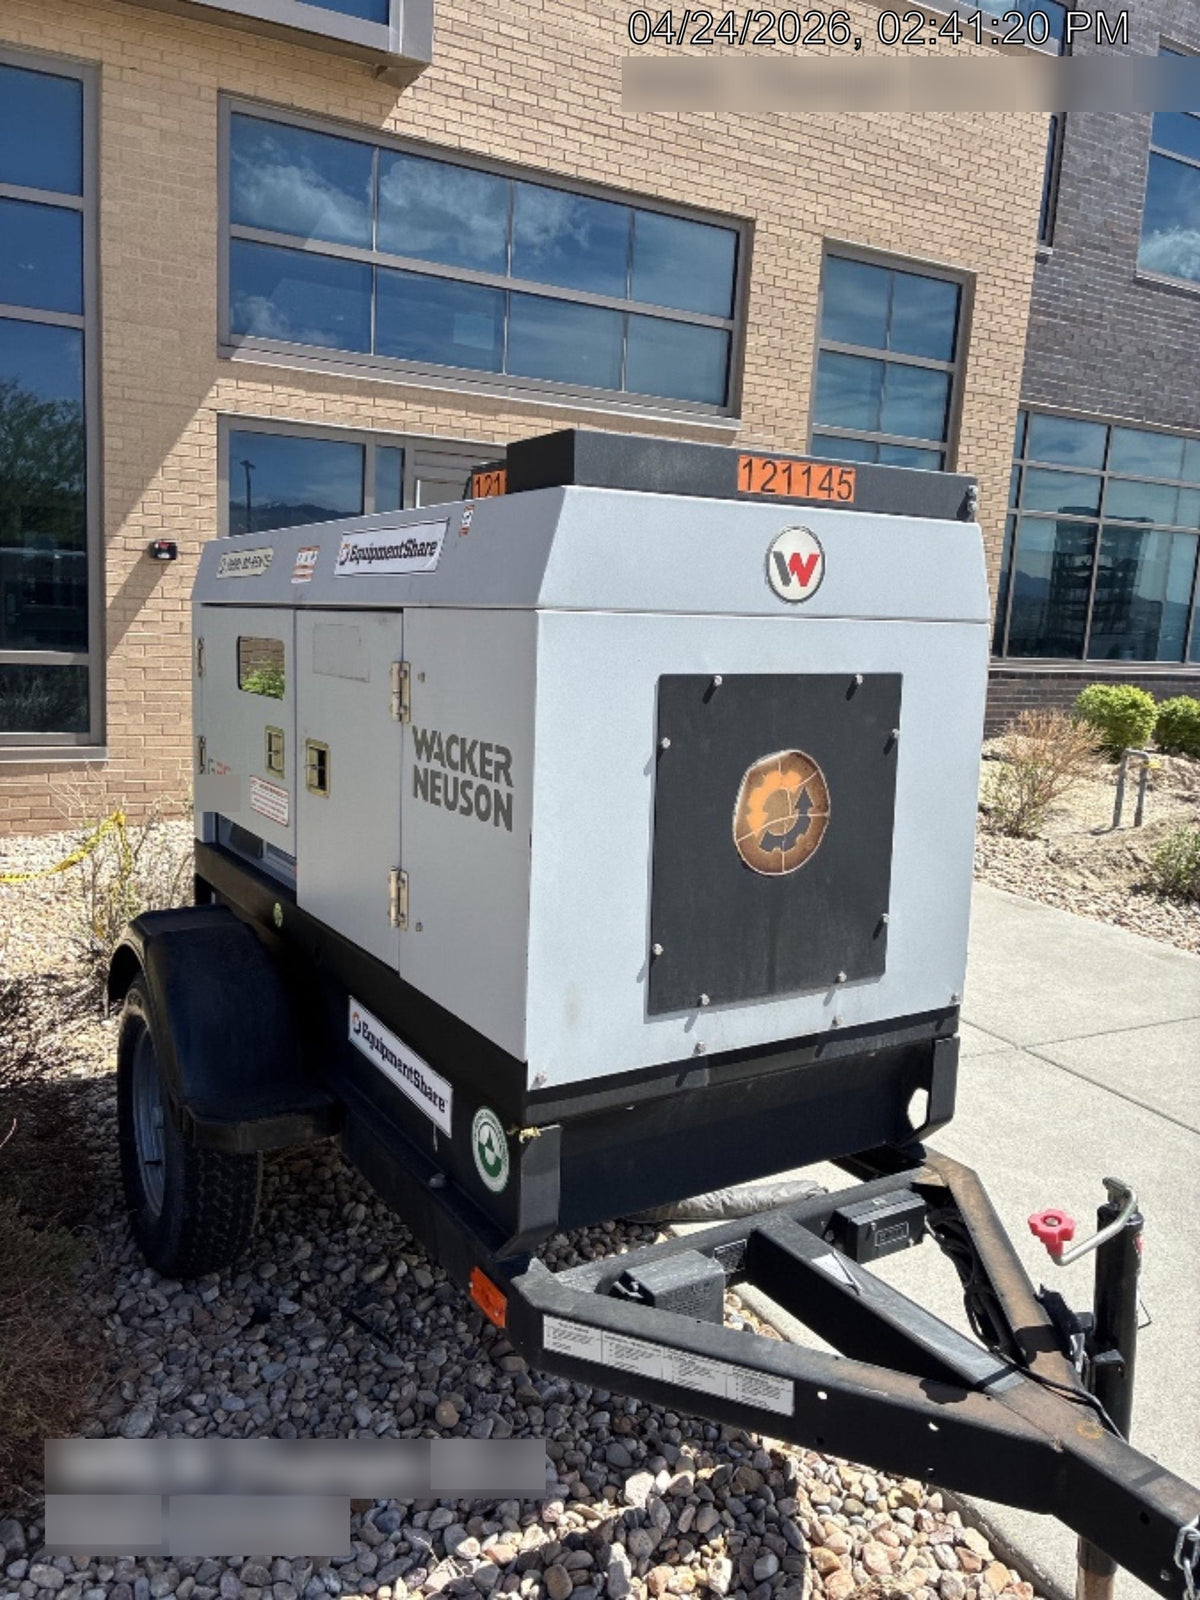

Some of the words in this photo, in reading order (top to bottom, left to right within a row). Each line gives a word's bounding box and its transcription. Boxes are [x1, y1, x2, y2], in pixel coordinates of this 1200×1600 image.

[742, 458, 853, 500] 121145
[350, 538, 438, 565] EquipmentShare
[412, 725, 514, 788] WACKER
[413, 764, 513, 832] NEUSON
[362, 1023, 446, 1113] EquipmentShare
